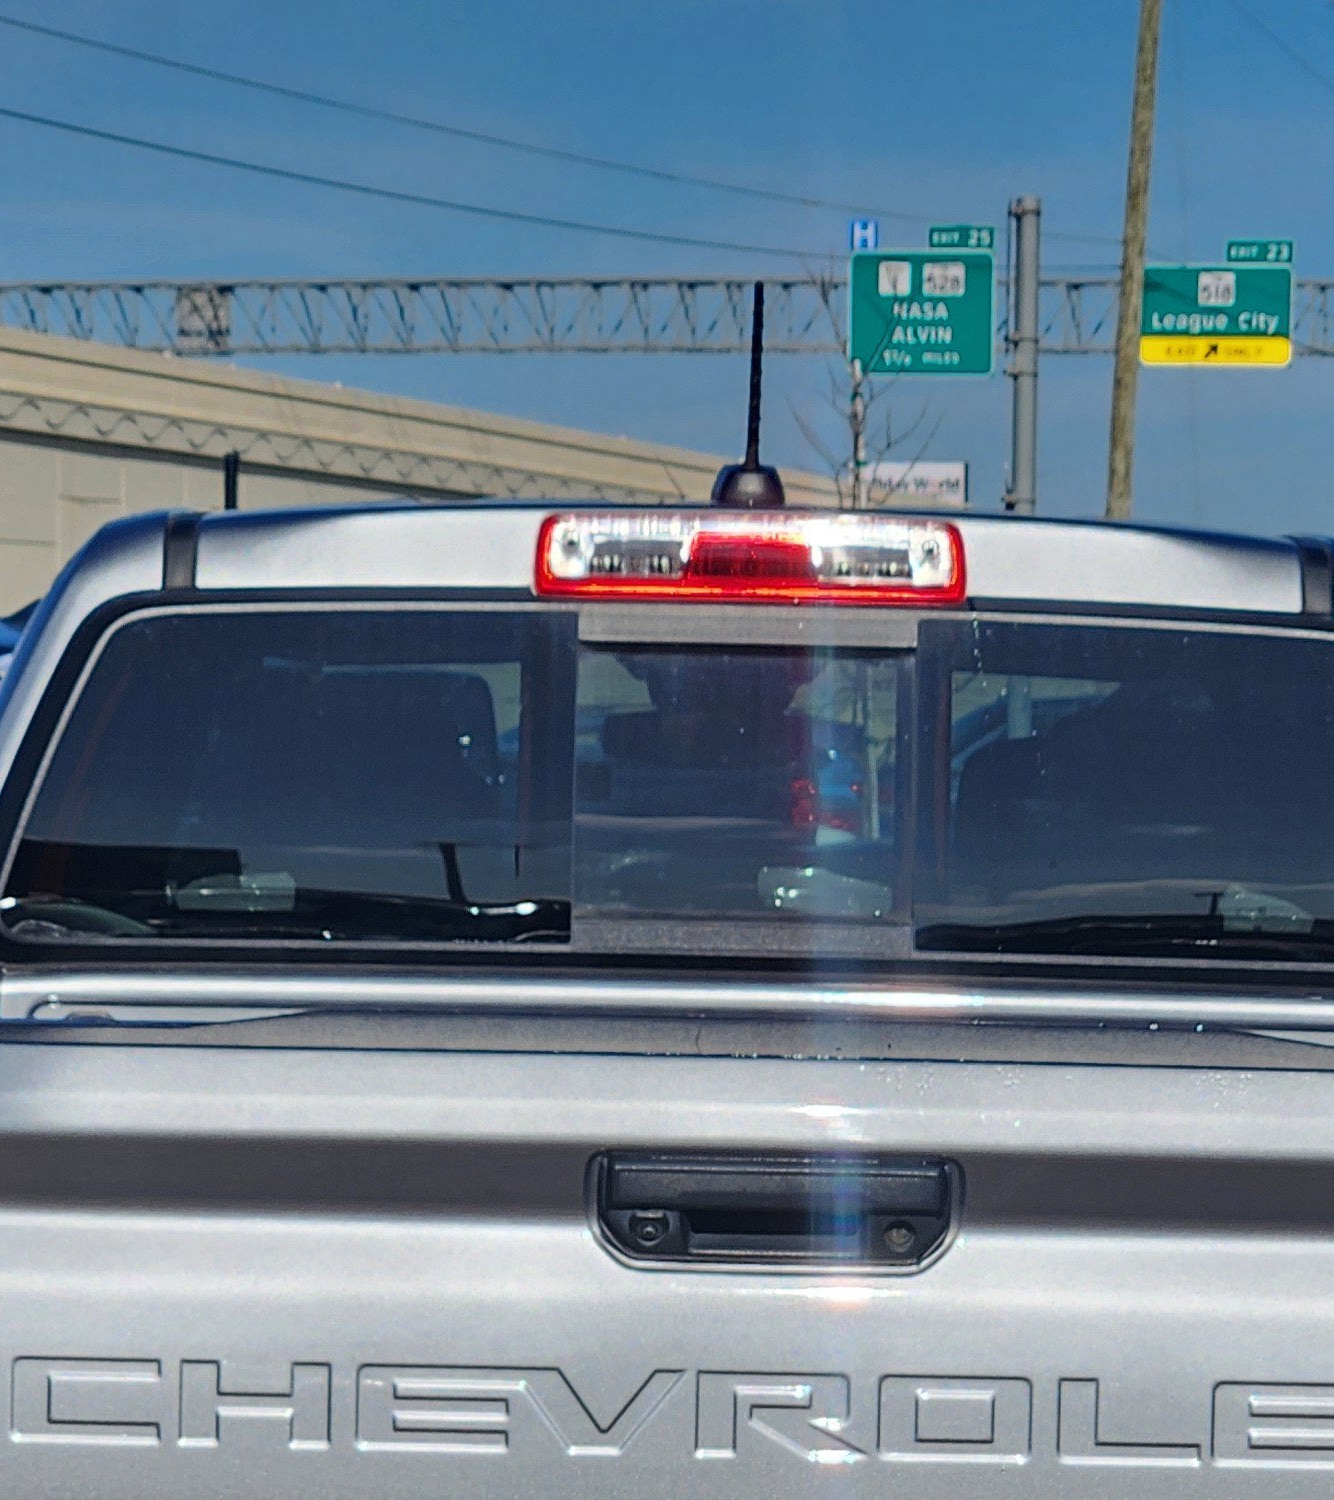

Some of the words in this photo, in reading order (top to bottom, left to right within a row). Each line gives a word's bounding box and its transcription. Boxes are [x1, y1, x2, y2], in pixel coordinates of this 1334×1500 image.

[1230, 245, 1258, 258] EXIT
[1266, 243, 1290, 261] 23
[893, 301, 949, 320] NASA
[1152, 311, 1228, 335] League
[1238, 311, 1279, 335] City
[892, 325, 953, 345] ALVIN
